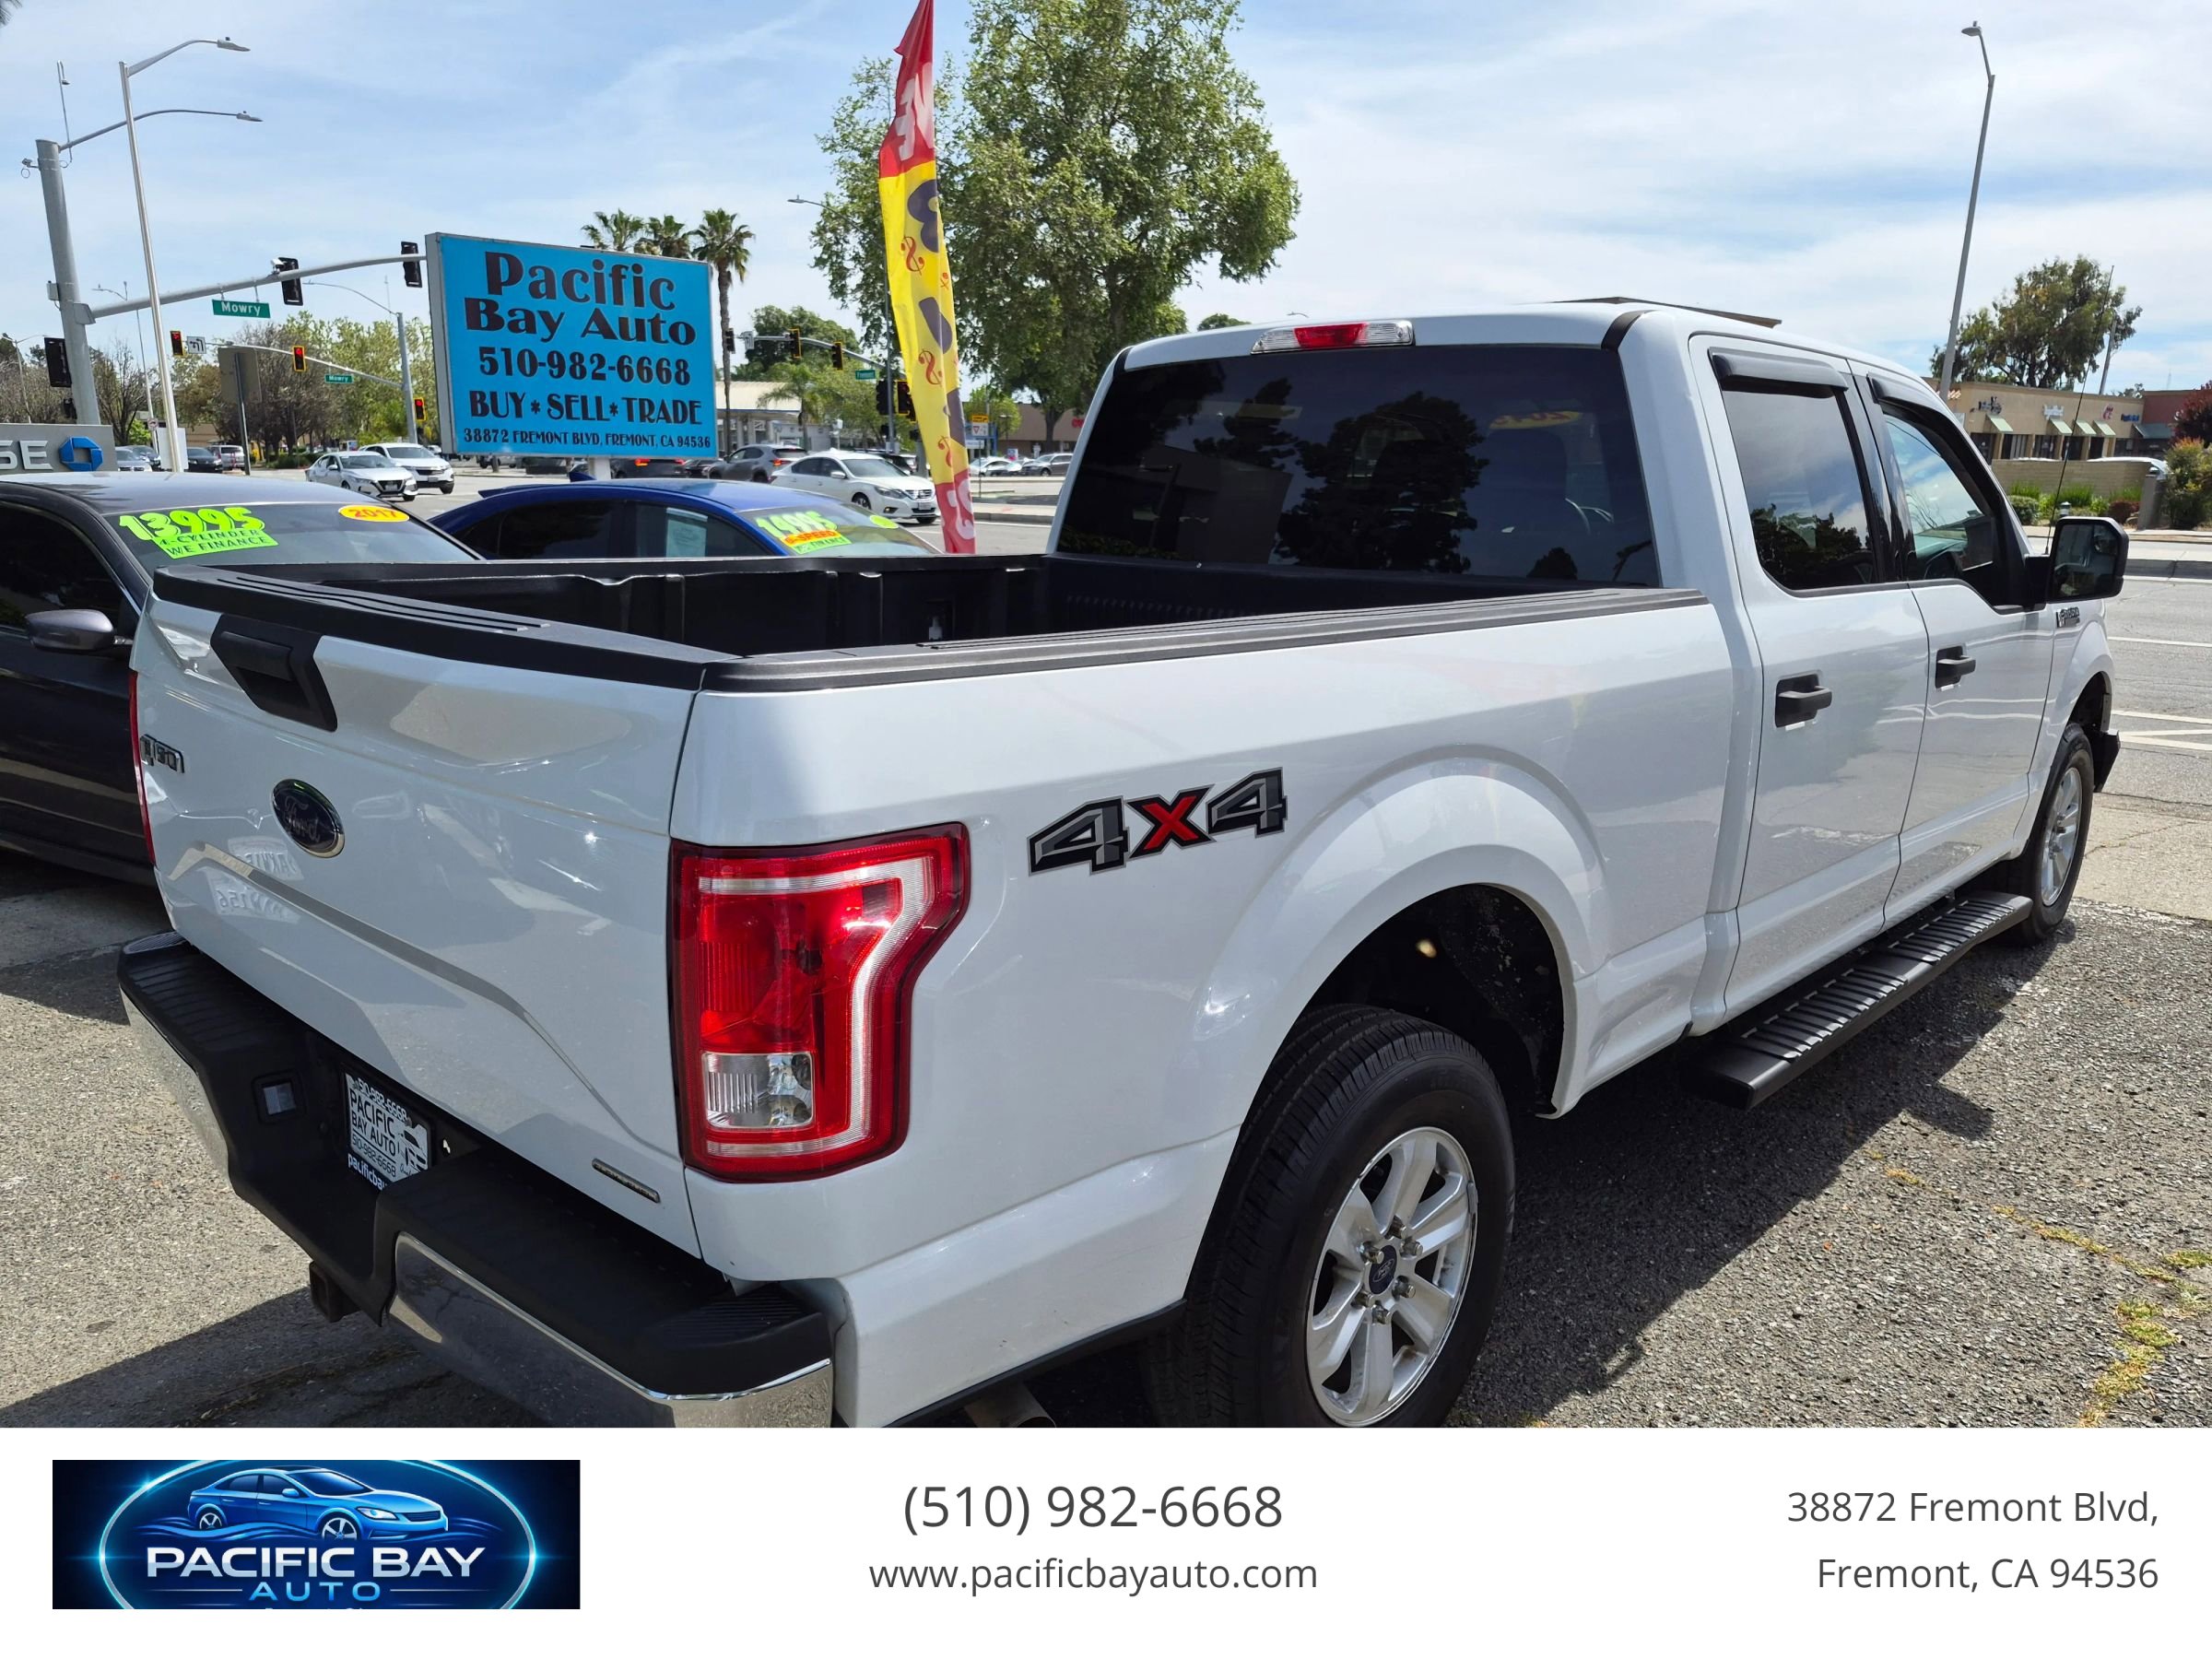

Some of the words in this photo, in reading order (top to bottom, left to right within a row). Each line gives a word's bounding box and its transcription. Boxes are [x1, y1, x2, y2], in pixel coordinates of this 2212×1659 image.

[485, 251, 676, 311] Pacific
[221, 301, 261, 315] Mowry
[464, 297, 565, 342] Bay
[581, 308, 696, 346] Auto
[329, 375, 349, 383] Mowry
[478, 346, 690, 385] 510-982-6668
[464, 428, 509, 443] 38872
[512, 429, 569, 444] FREMONT
[661, 435, 674, 448] CA
[677, 436, 711, 448] 94536
[119, 507, 265, 540] 13995
[348, 509, 397, 518] 2017
[167, 544, 194, 556] WE
[198, 536, 269, 551] FINANCE
[349, 1088, 395, 1139] PACIFIC
[351, 1111, 368, 1135] BAY
[371, 1125, 396, 1157] AUTO
